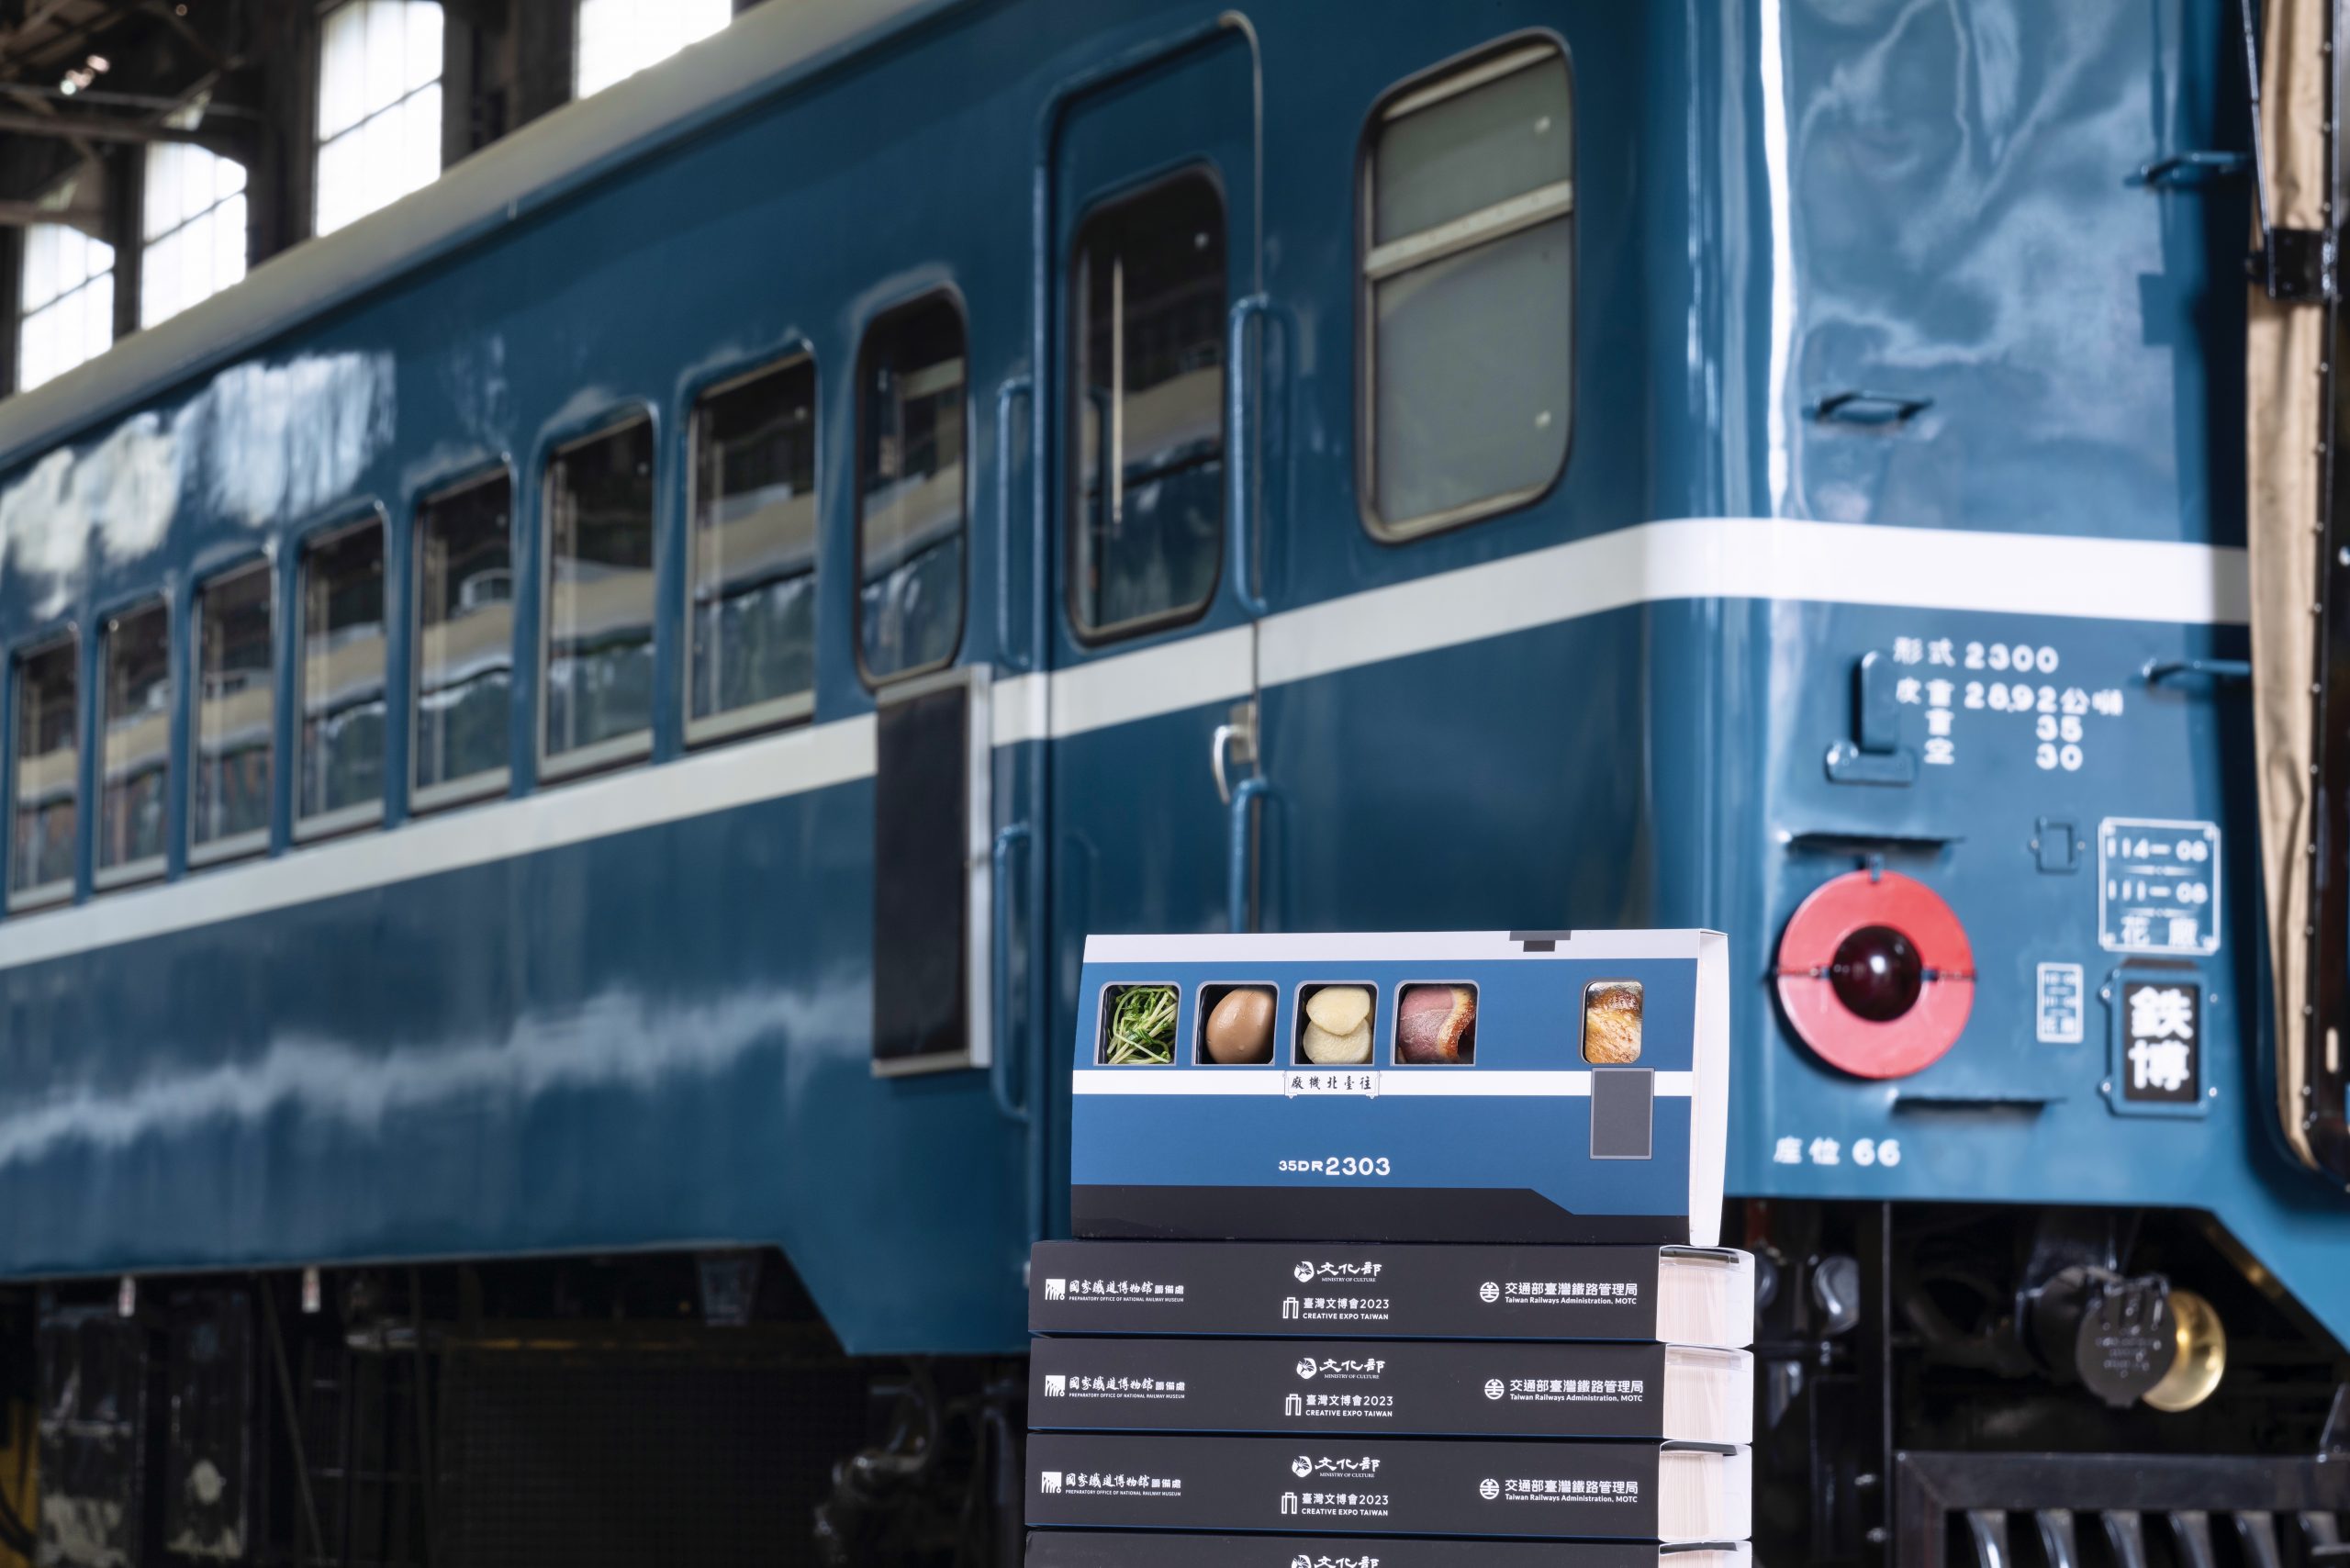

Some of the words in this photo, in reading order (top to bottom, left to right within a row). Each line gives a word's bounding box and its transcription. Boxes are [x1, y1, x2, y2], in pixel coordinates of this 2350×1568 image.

[1964, 642, 2059, 674] 2300
[2036, 714, 2083, 743] 35
[2036, 743, 2083, 771] 30
[1852, 1137, 1901, 1167] 66
[1317, 1261, 1382, 1276] 文化部
[1319, 1359, 1385, 1373] 文化部
[1315, 1457, 1380, 1472] 文化部
